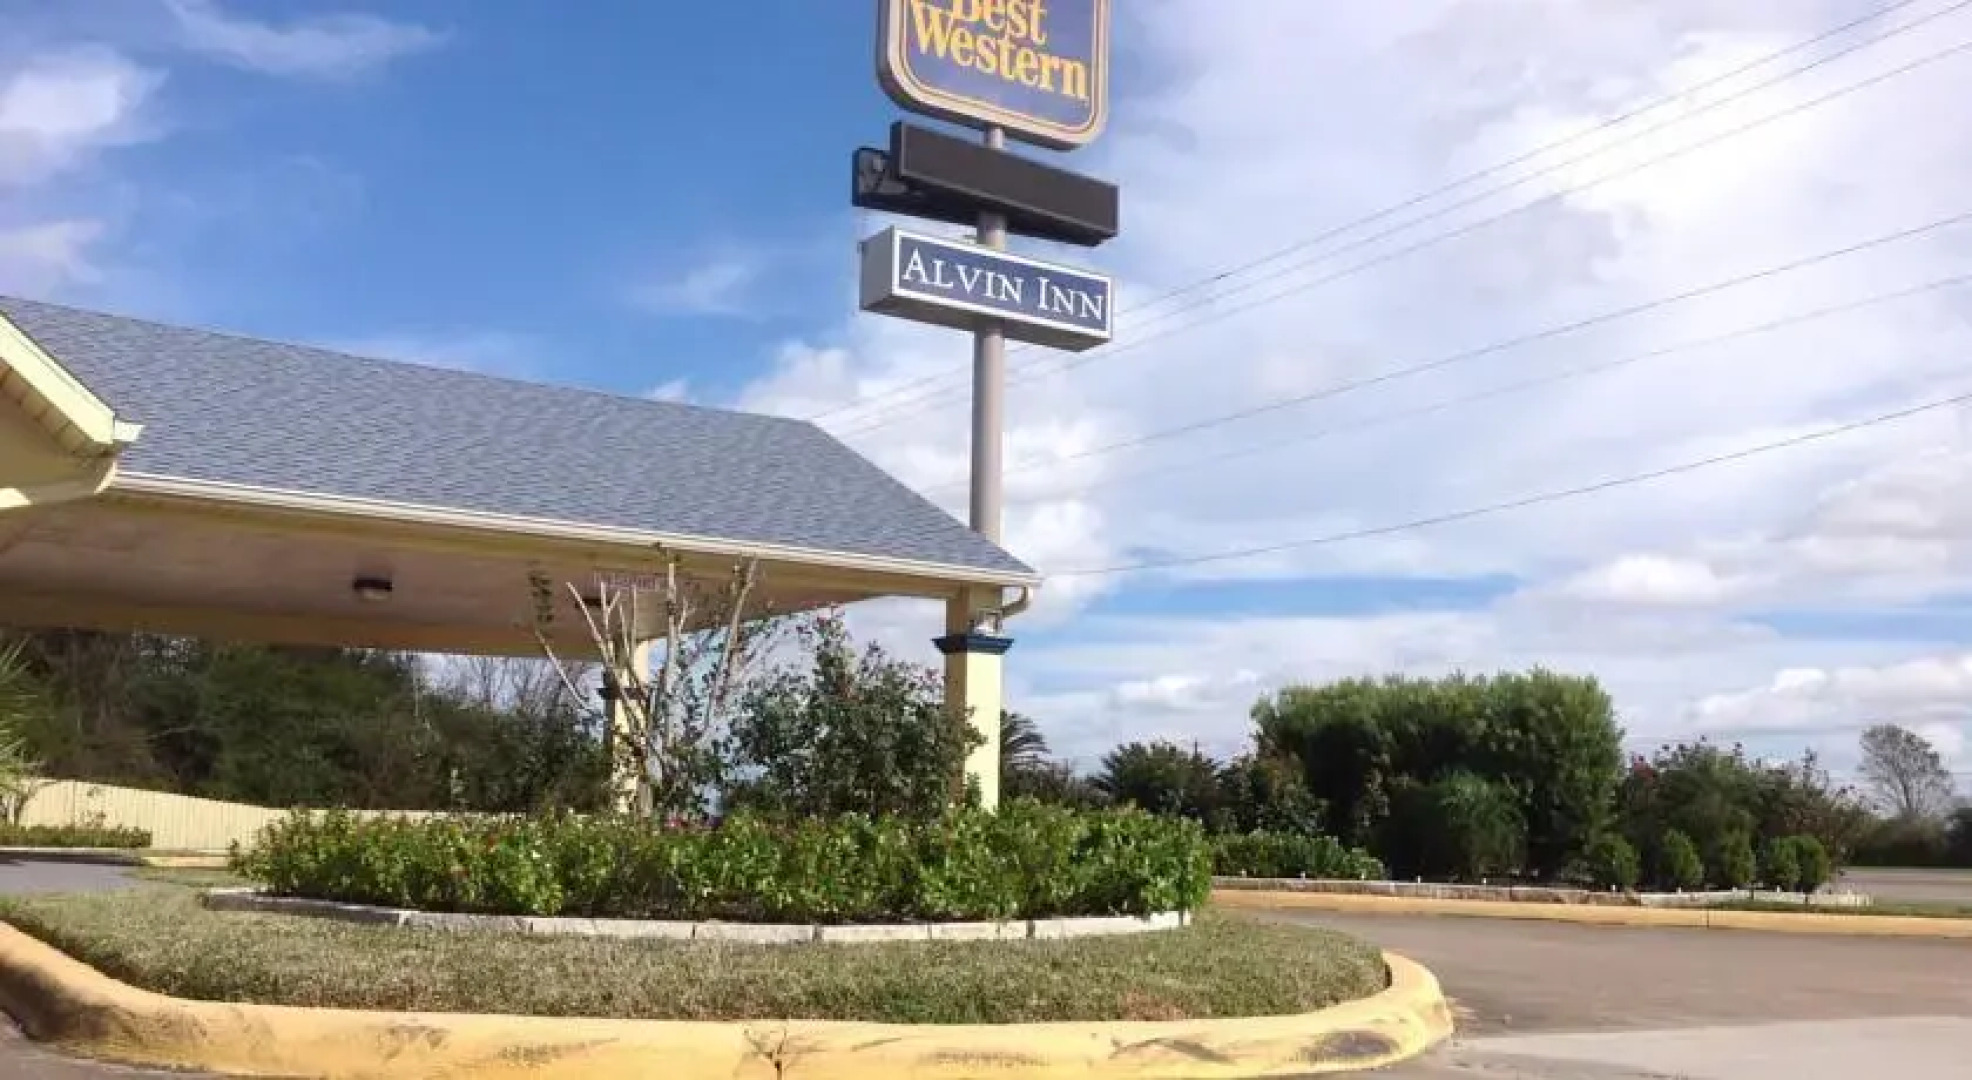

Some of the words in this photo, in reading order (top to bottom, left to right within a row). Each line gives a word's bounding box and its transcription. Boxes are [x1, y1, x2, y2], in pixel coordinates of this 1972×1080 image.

[908, 1, 1089, 100] Western
[903, 249, 1023, 302] ALVIN
[1039, 277, 1102, 320] INN
